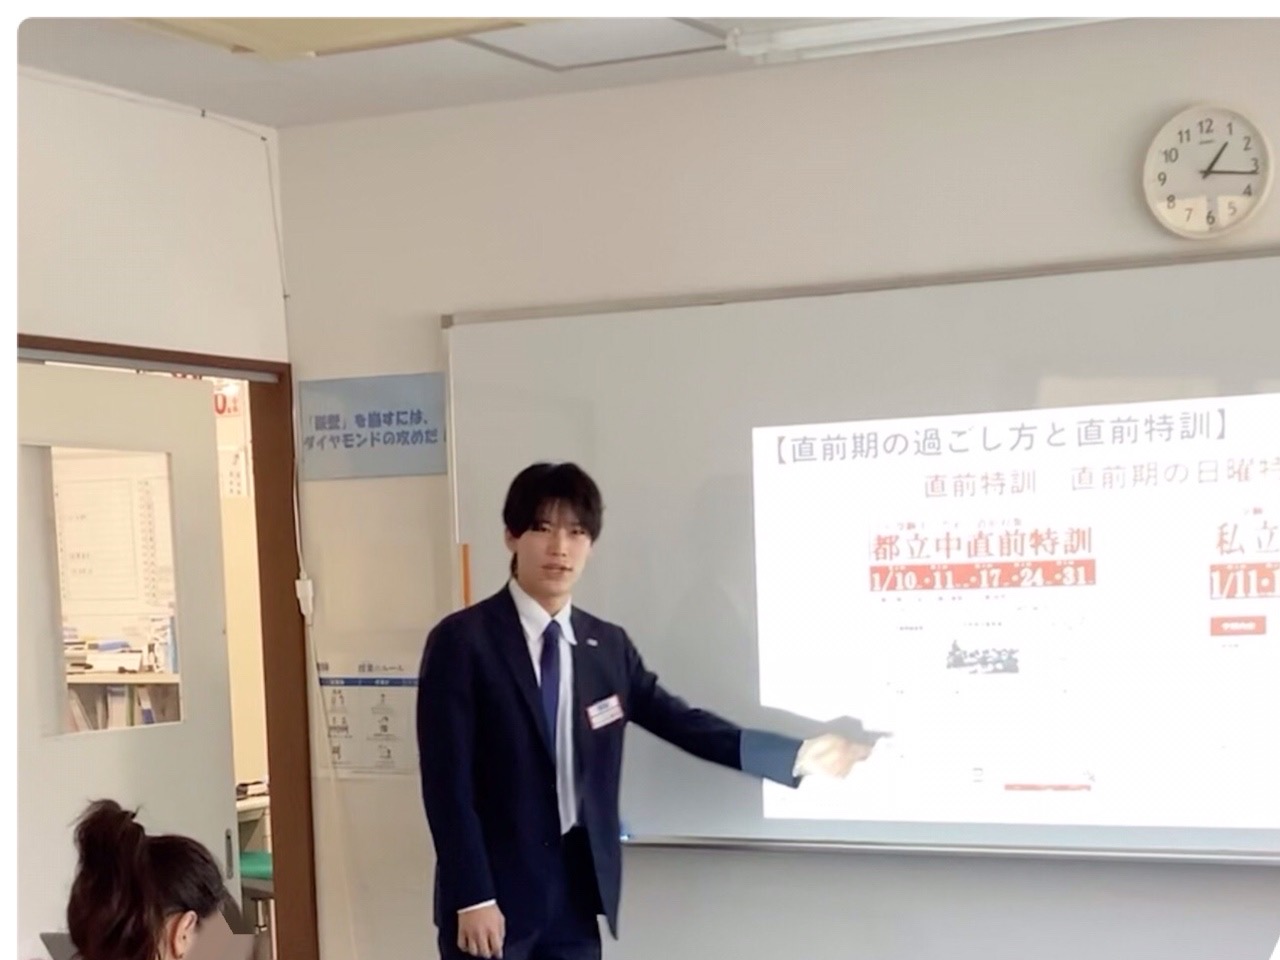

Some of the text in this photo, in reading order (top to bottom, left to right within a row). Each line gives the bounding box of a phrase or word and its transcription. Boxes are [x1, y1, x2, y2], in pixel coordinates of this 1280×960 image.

[1198, 118, 1214, 134] 12
[1227, 122, 1234, 135] 1
[1178, 129, 1191, 143] 11
[1243, 136, 1253, 151] 2
[1163, 147, 1179, 163] 10
[1251, 158, 1260, 171] 3
[1157, 172, 1167, 186] 9
[1242, 184, 1253, 197] 4
[1166, 195, 1176, 209] 8
[1228, 202, 1237, 216] 5
[1185, 208, 1193, 222] 7
[1206, 211, 1216, 225] 6
[777, 407, 1229, 466] 【直前期の過ごし方と直前特訓】
[923, 468, 1037, 499] 直前特訓
[872, 526, 1093, 561] 都立中直前特訓
